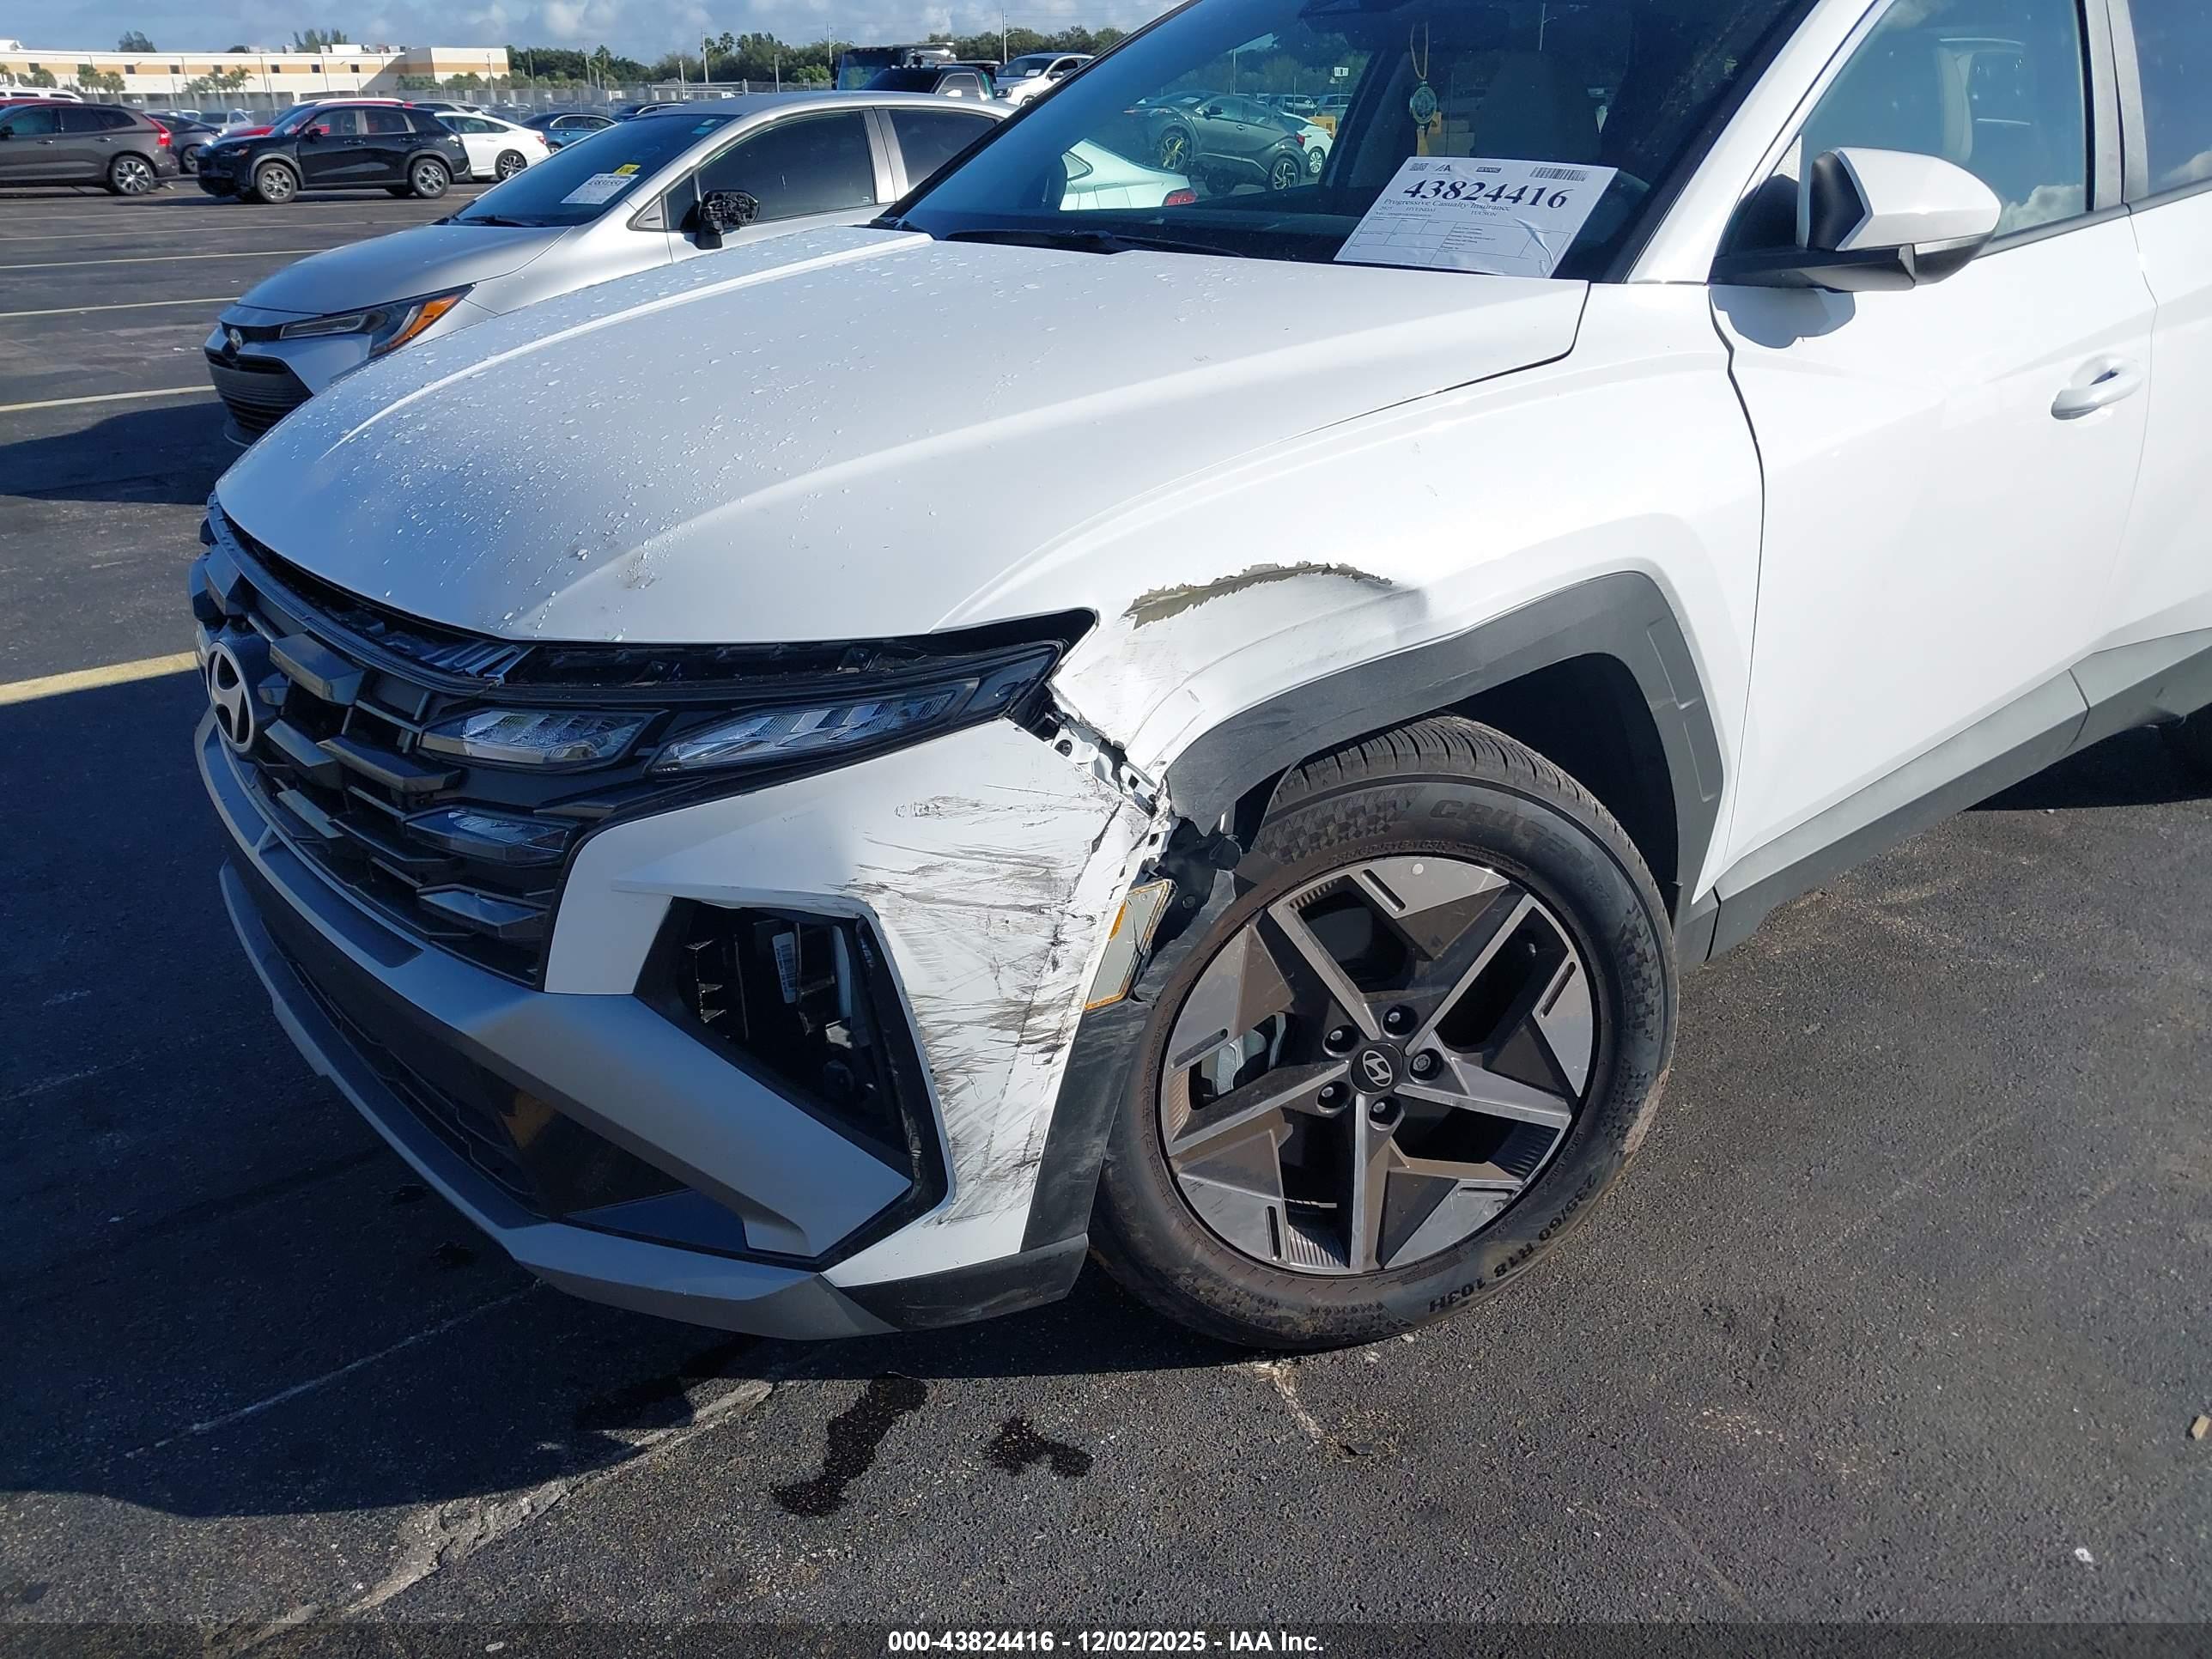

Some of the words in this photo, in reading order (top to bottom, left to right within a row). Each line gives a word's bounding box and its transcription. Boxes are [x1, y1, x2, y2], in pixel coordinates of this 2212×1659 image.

[1403, 179, 1575, 209] 43824416
[1432, 200, 1468, 209] Casualty
[1470, 203, 1511, 211] Insurance
[1538, 1173, 1598, 1243] 235/60
[1492, 1243, 1535, 1278] R18
[1428, 1277, 1487, 1312] 103H
